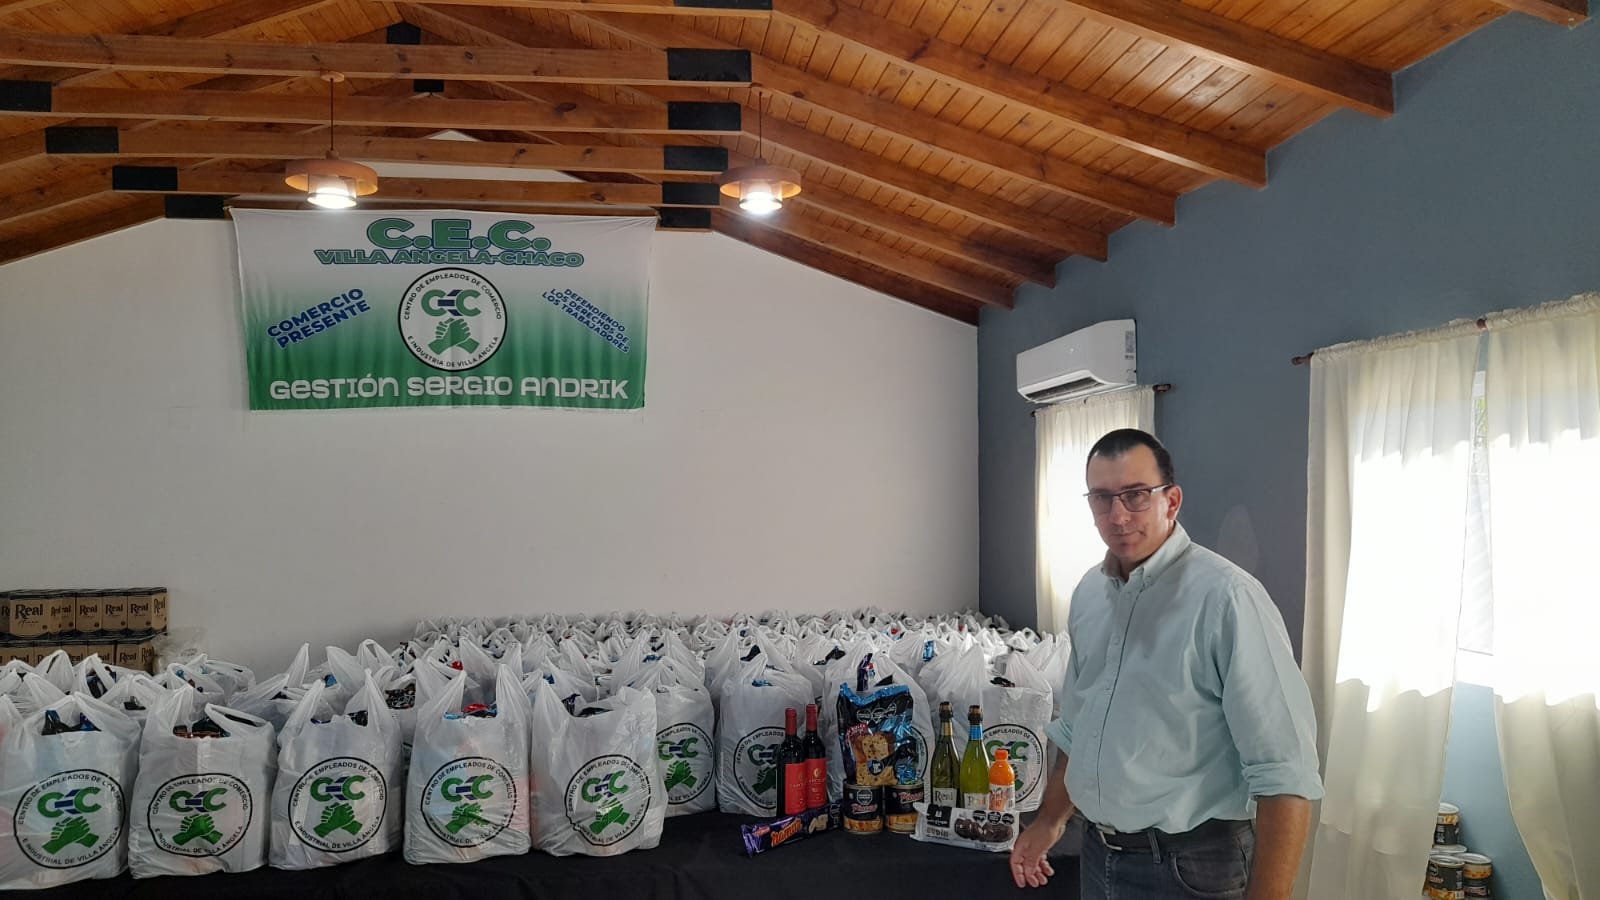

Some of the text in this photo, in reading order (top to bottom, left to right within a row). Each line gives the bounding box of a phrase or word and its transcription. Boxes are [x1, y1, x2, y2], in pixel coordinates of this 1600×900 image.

[366, 218, 551, 251] C.E.C.
[314, 249, 584, 267] VILLA ANGELA-CHACO
[267, 288, 363, 336] COMERCIO
[404, 273, 502, 320] CENTRO DE EMPLEADOS DE COMERCIO
[564, 288, 625, 332] DEFENDIENDO
[277, 300, 371, 348] PRESENTE
[542, 292, 630, 352] LOS TRABAJADORES
[550, 288, 630, 343] LOS DERECHOS DE
[410, 341, 444, 366] INDUSTRIA
[457, 358, 478, 367] VILLA
[478, 337, 498, 360] ANGELA
[16, 604, 43, 619] Real
[80, 604, 98, 615] Real
[106, 604, 123, 614] Real
[130, 602, 148, 614] Real
[154, 597, 165, 614] Real
[120, 653, 136, 663] Real
[314, 762, 357, 776] EMPLEADOS
[425, 780, 438, 805] CENTRO
[438, 772, 446, 780] DE
[446, 762, 486, 774] EMPLEADOS
[18, 797, 32, 825] CENTRO
[31, 789, 41, 798] DE
[41, 774, 89, 790] EMPLEADOS
[153, 791, 167, 814] CENTRO
[229, 782, 248, 811] COMERCIO
[936, 790, 953, 803] Real
[77, 851, 98, 862] VILLA
[99, 826, 119, 851] ANGELA
[222, 826, 242, 848] ANGELA
[342, 838, 362, 848] VILLA
[362, 816, 380, 839] ANGELA
[615, 826, 630, 837] VILLA
